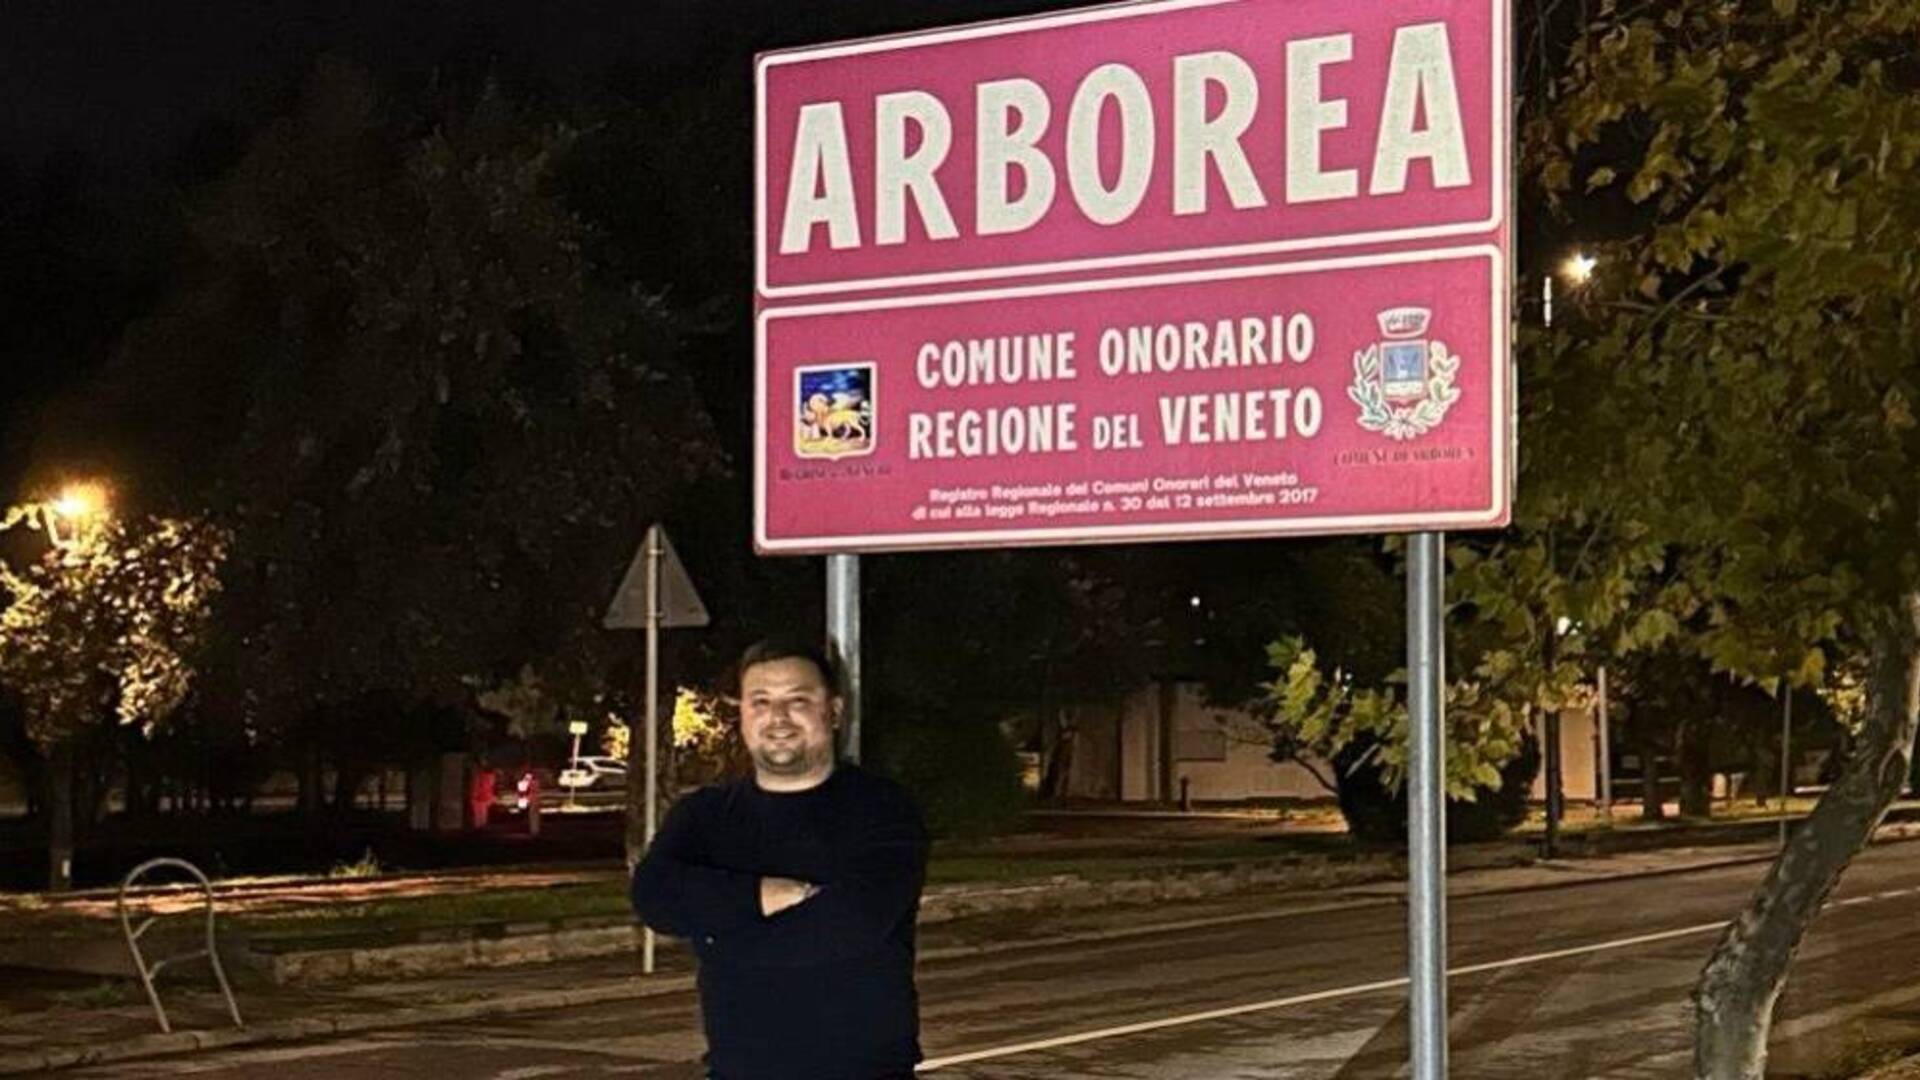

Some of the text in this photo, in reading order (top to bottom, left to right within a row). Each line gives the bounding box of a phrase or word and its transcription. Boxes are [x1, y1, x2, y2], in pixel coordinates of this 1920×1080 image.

[779, 22, 1472, 255] ARBOREA
[917, 313, 1314, 388] COMUNE ONORARIO
[908, 387, 1322, 459] REGIONE DEL VENETO
[929, 488, 988, 503] Registro
[991, 483, 1062, 501] Regionale
[1092, 479, 1149, 494] Comuni
[1153, 475, 1210, 491] Onorari
[1243, 471, 1298, 487] Veneto
[1027, 500, 1100, 517] Regionale
[1120, 495, 1142, 511] 30
[1175, 494, 1192, 508] 12
[1196, 490, 1275, 507] settembre
[1279, 487, 1319, 504] 2017
